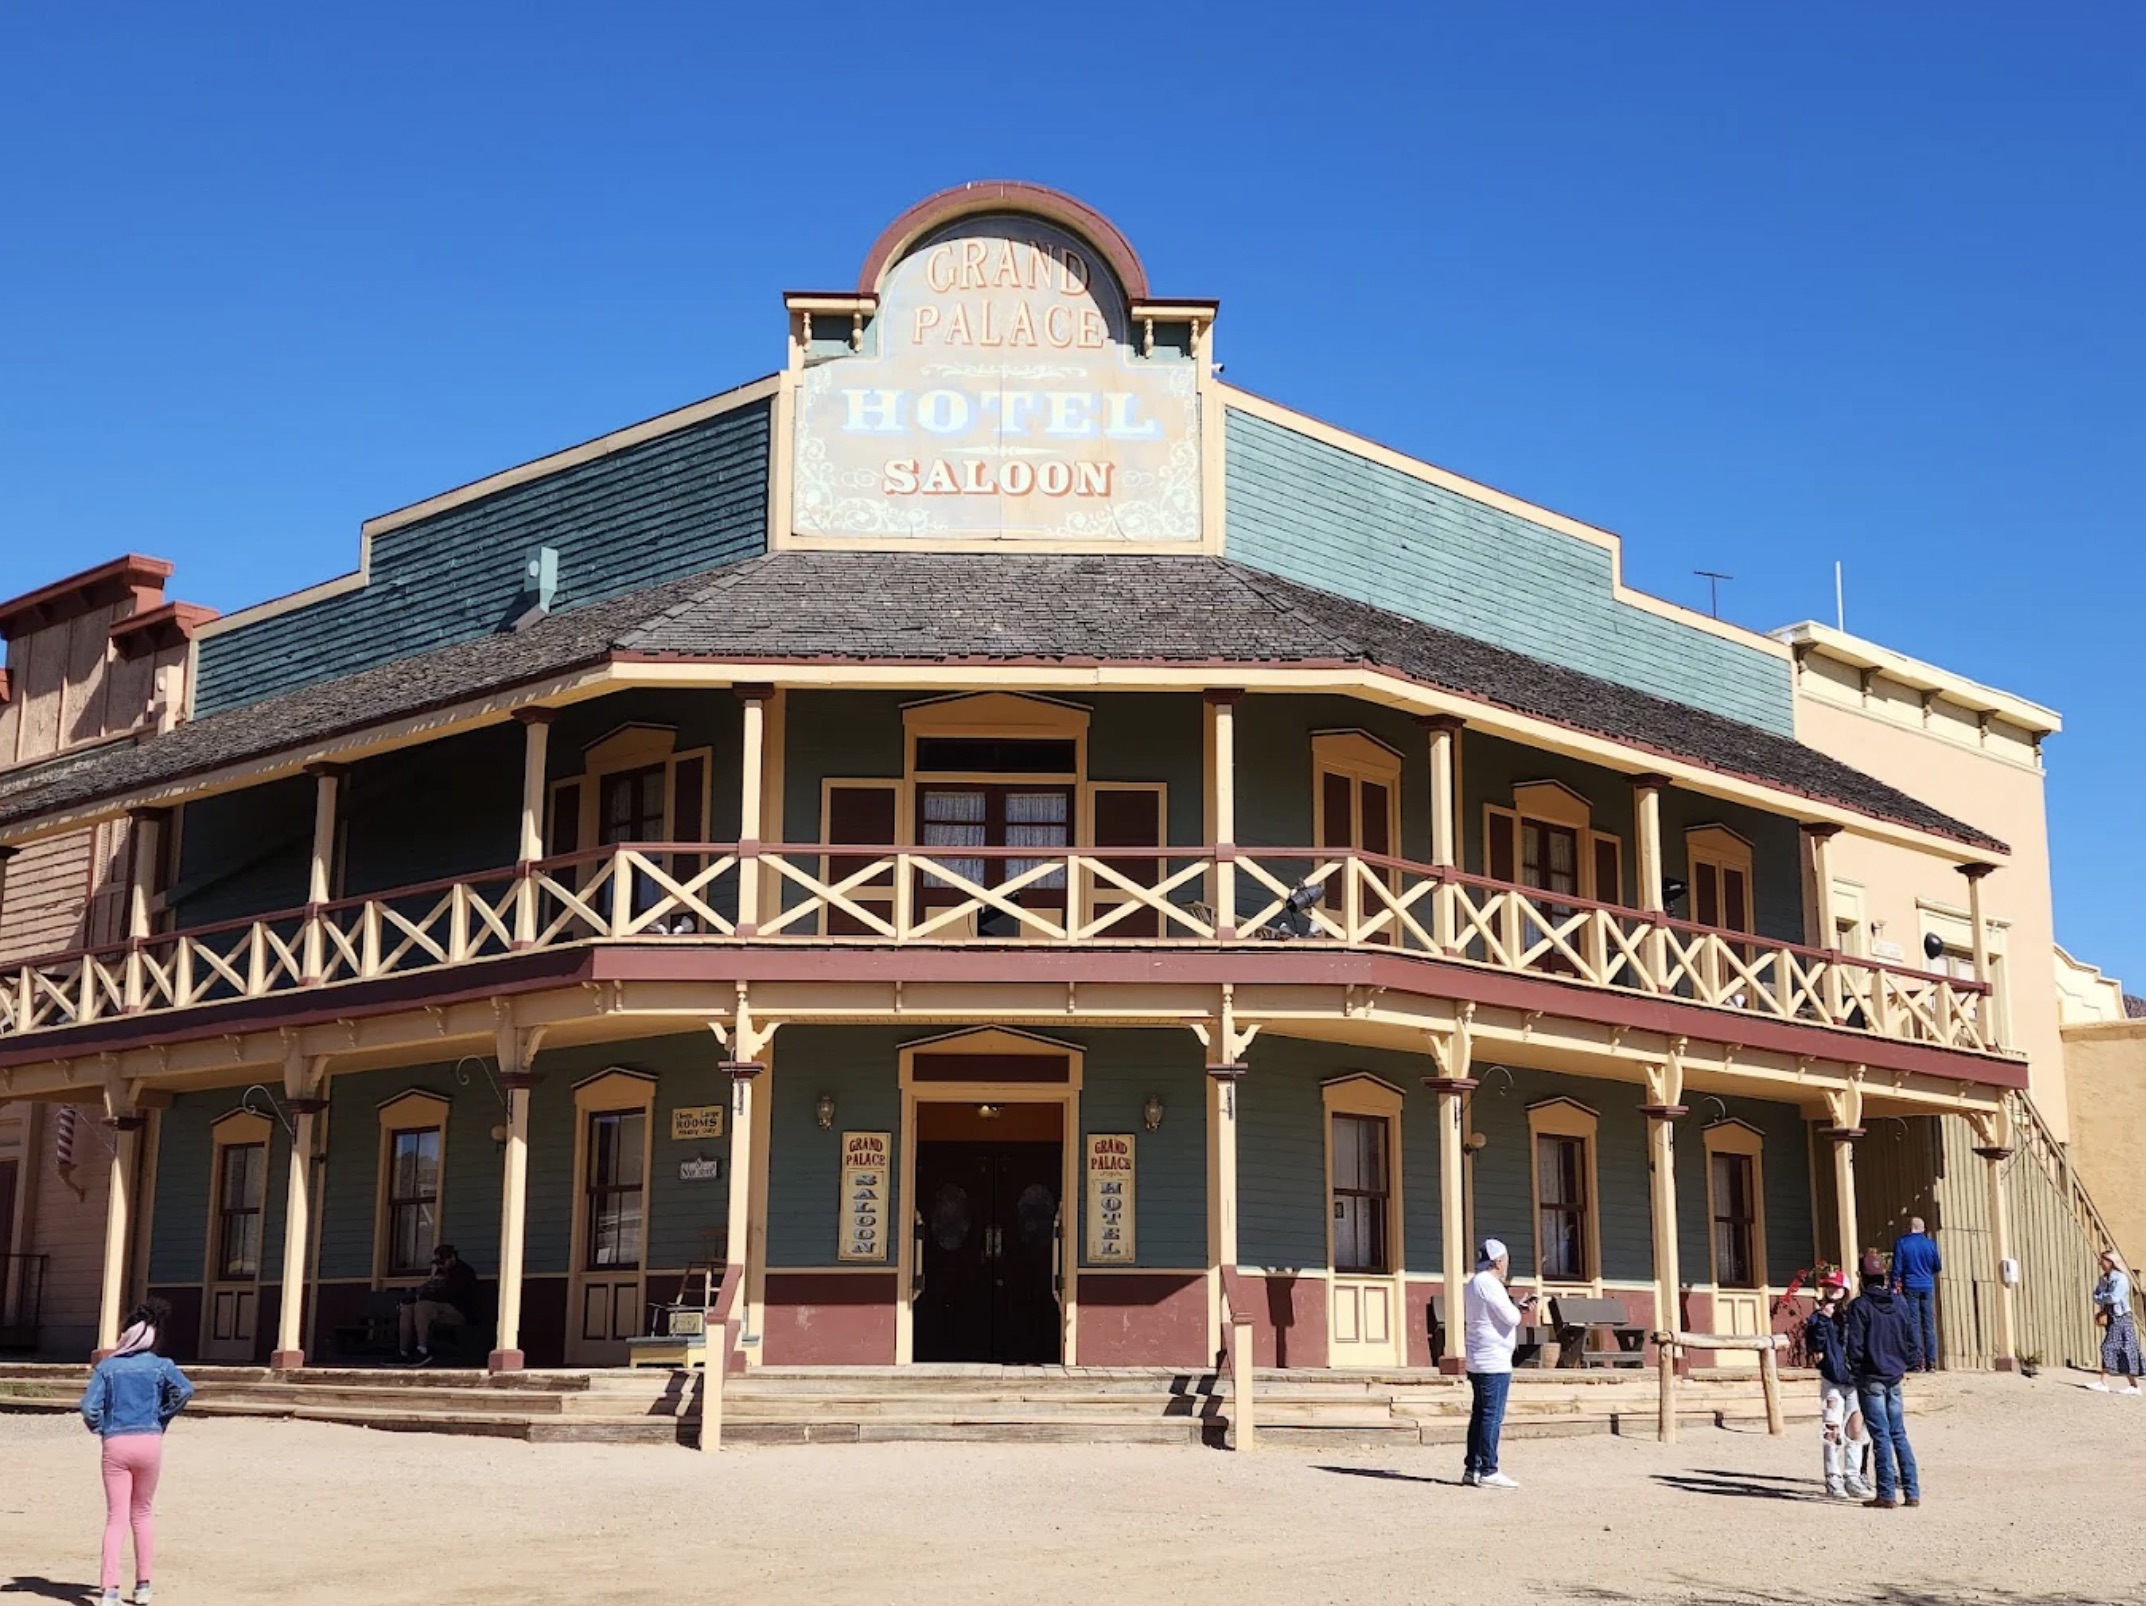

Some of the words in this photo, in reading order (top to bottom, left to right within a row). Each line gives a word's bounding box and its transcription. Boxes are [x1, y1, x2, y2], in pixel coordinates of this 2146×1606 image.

[926, 237, 1091, 295] GRAND
[912, 299, 1104, 349] PALACE
[841, 387, 1162, 440] HOTEL
[882, 459, 1115, 496] SALOON
[676, 1118, 717, 1129] ROOMS
[846, 1153, 886, 1166] PALACE
[849, 1137, 883, 1152] GRAND
[1091, 1155, 1132, 1170] PALACE
[1094, 1138, 1127, 1154] GRAND
[852, 1174, 879, 1253] SALOON
[1100, 1182, 1123, 1255] HOTEL
